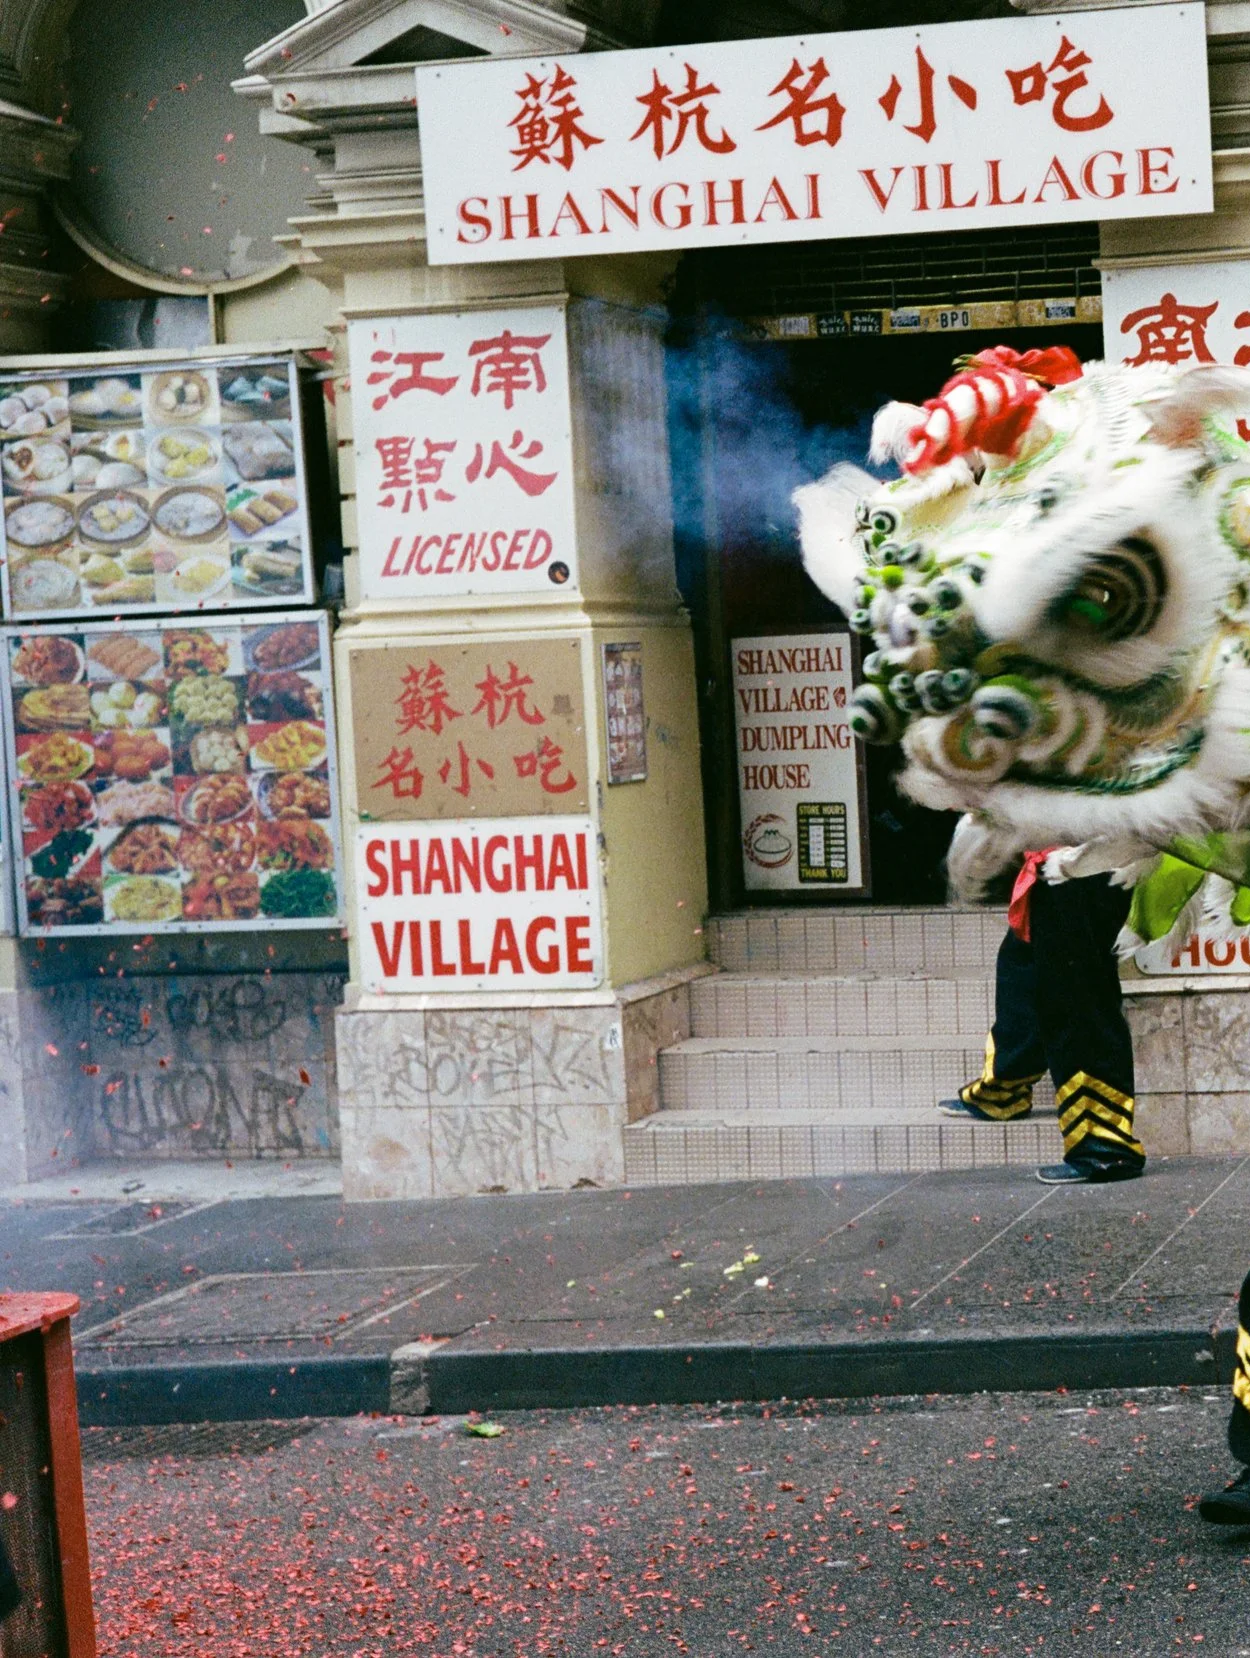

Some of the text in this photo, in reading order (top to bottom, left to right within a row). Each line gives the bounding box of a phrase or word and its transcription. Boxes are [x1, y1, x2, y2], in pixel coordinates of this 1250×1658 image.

[507, 35, 1114, 172] 蘇杭名小吃
[456, 146, 1180, 245] SHANGHAI VILLAGE
[366, 329, 552, 412] 江南
[374, 429, 558, 513] 點心
[380, 528, 553, 578] LICENSED
[737, 646, 843, 675] SHANGHAI
[395, 659, 546, 736] 蘇杭
[738, 686, 829, 714] VILLAGE
[371, 735, 578, 800] 名小吃
[741, 724, 851, 752] DUMPLING
[743, 763, 811, 790] HOUSE
[365, 832, 589, 898] SHANGHAI
[370, 915, 594, 978] VILLAGE
